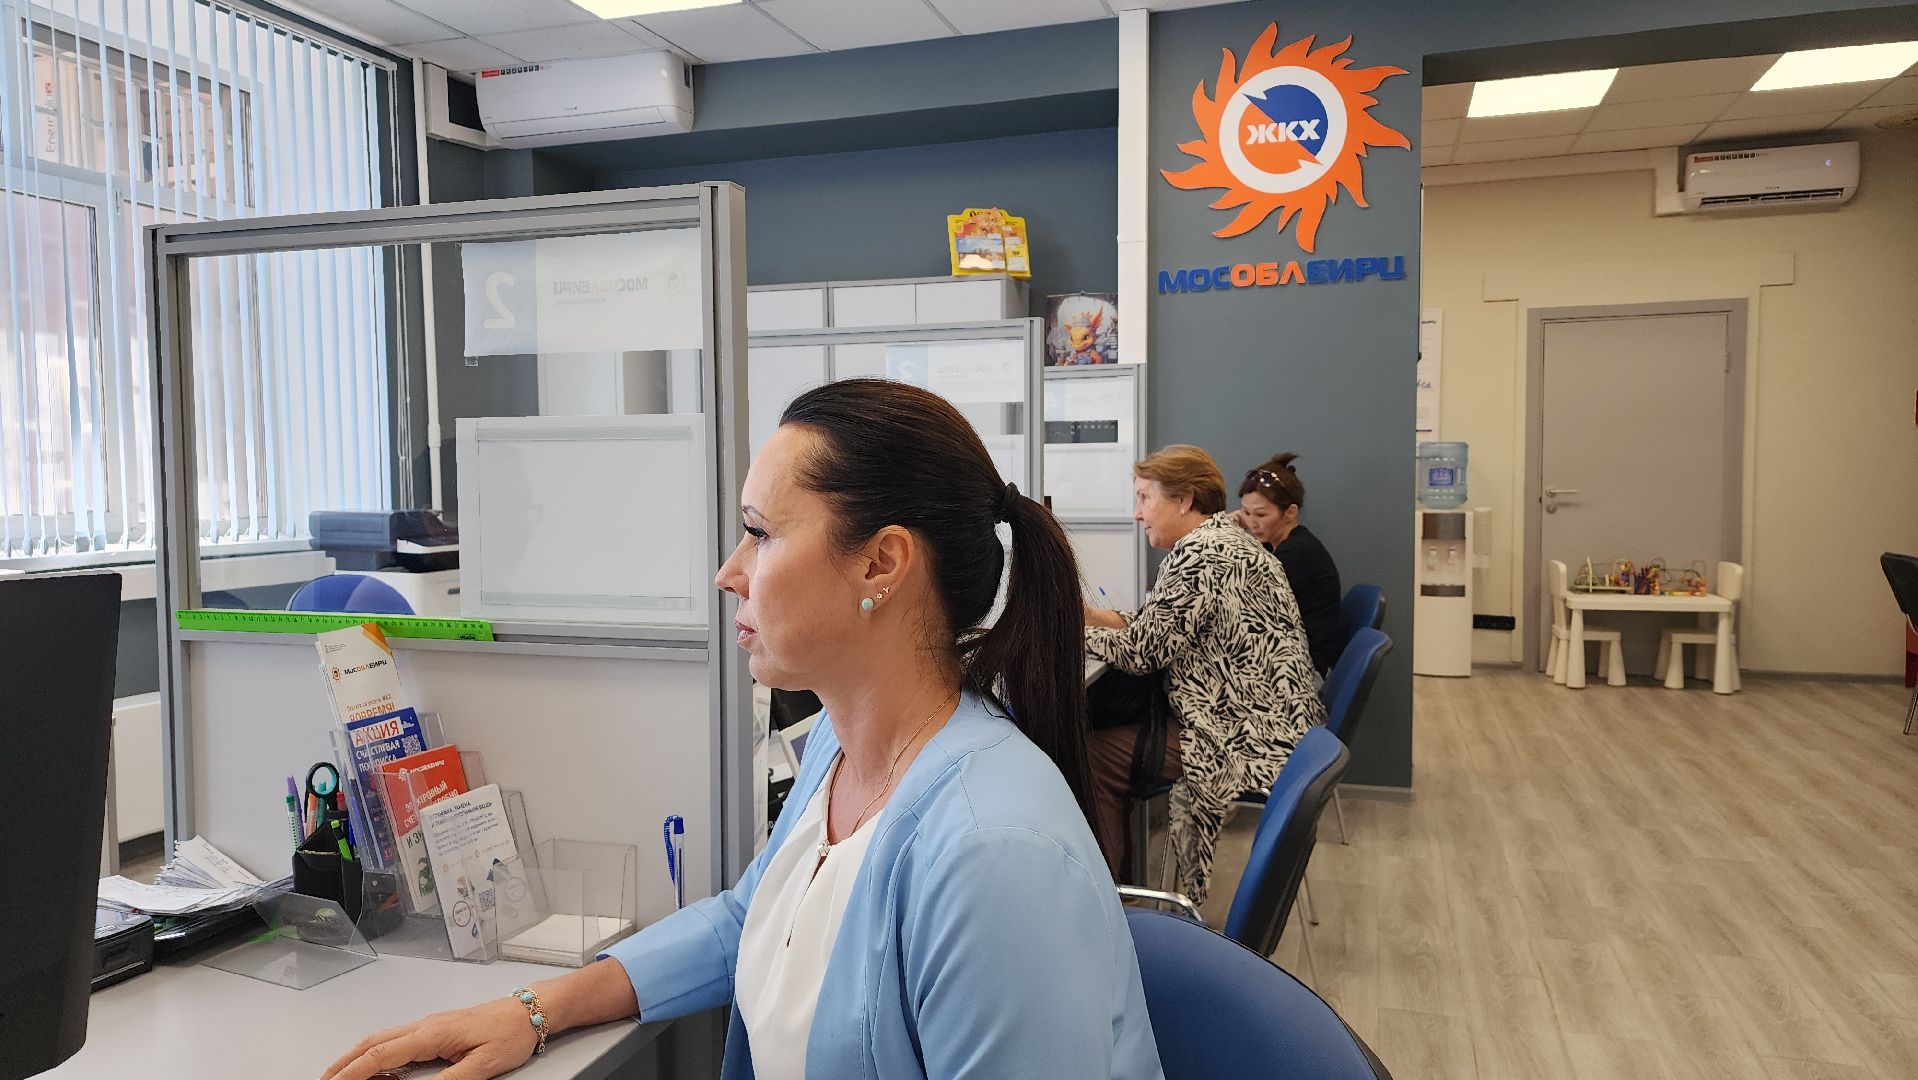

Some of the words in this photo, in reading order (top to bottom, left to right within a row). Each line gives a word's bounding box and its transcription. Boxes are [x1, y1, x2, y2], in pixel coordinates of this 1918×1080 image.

[1246, 119, 1320, 145] ЖКХ
[1158, 256, 1405, 294] МОСОБЛЕИРЦ
[355, 720, 400, 746] АКЦИЯ
[358, 753, 397, 773] ПОПИСКА
[405, 780, 448, 813] ЭЛКТРОННЫЙ
